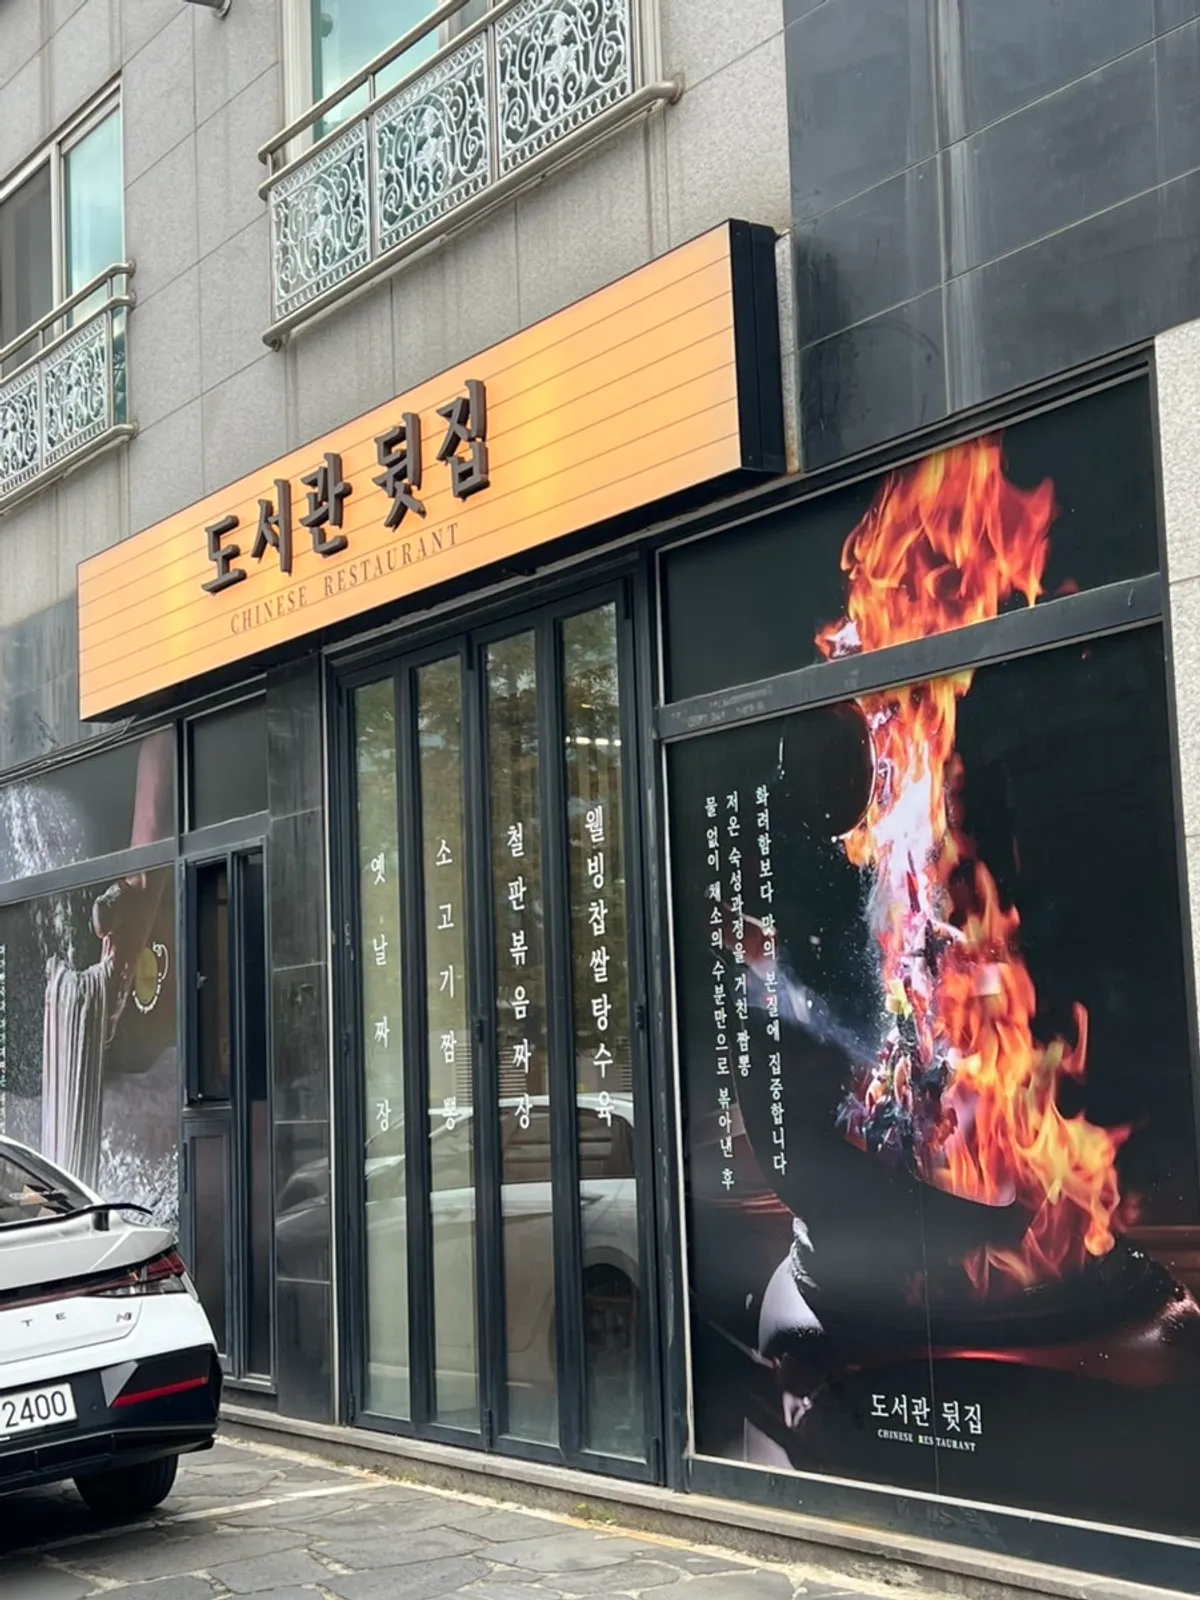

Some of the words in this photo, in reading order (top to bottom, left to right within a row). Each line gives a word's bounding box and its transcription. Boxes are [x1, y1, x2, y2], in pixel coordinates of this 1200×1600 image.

[201, 452, 353, 595] 도서관
[372, 379, 491, 532] 뒷집
[230, 585, 308, 635] CHINESE
[323, 522, 461, 597] RESTAURANT
[704, 796, 717, 818] 물
[726, 790, 741, 837] 저온
[706, 826, 719, 871] 없이
[755, 784, 774, 904] 화려함보다
[708, 881, 722, 950] 채소의
[728, 847, 747, 964] 숙성과정을
[761, 913, 777, 961] 맛의
[711, 961, 730, 1075] 수분만으로
[734, 973, 748, 1021] 거친
[764, 970, 780, 1043] 본질에
[736, 1029, 751, 1078] 짬뽕
[718, 1088, 733, 1158] 볶아낸
[768, 1052, 788, 1176] 집중합니다
[721, 1168, 735, 1191] 후
[2, 1390, 67, 1429] 2400
[870, 1393, 930, 1427] 도서관
[941, 1400, 982, 1435] 뒷집
[877, 1428, 914, 1443] CHINESE
[917, 1434, 977, 1452] RESTAURANT
